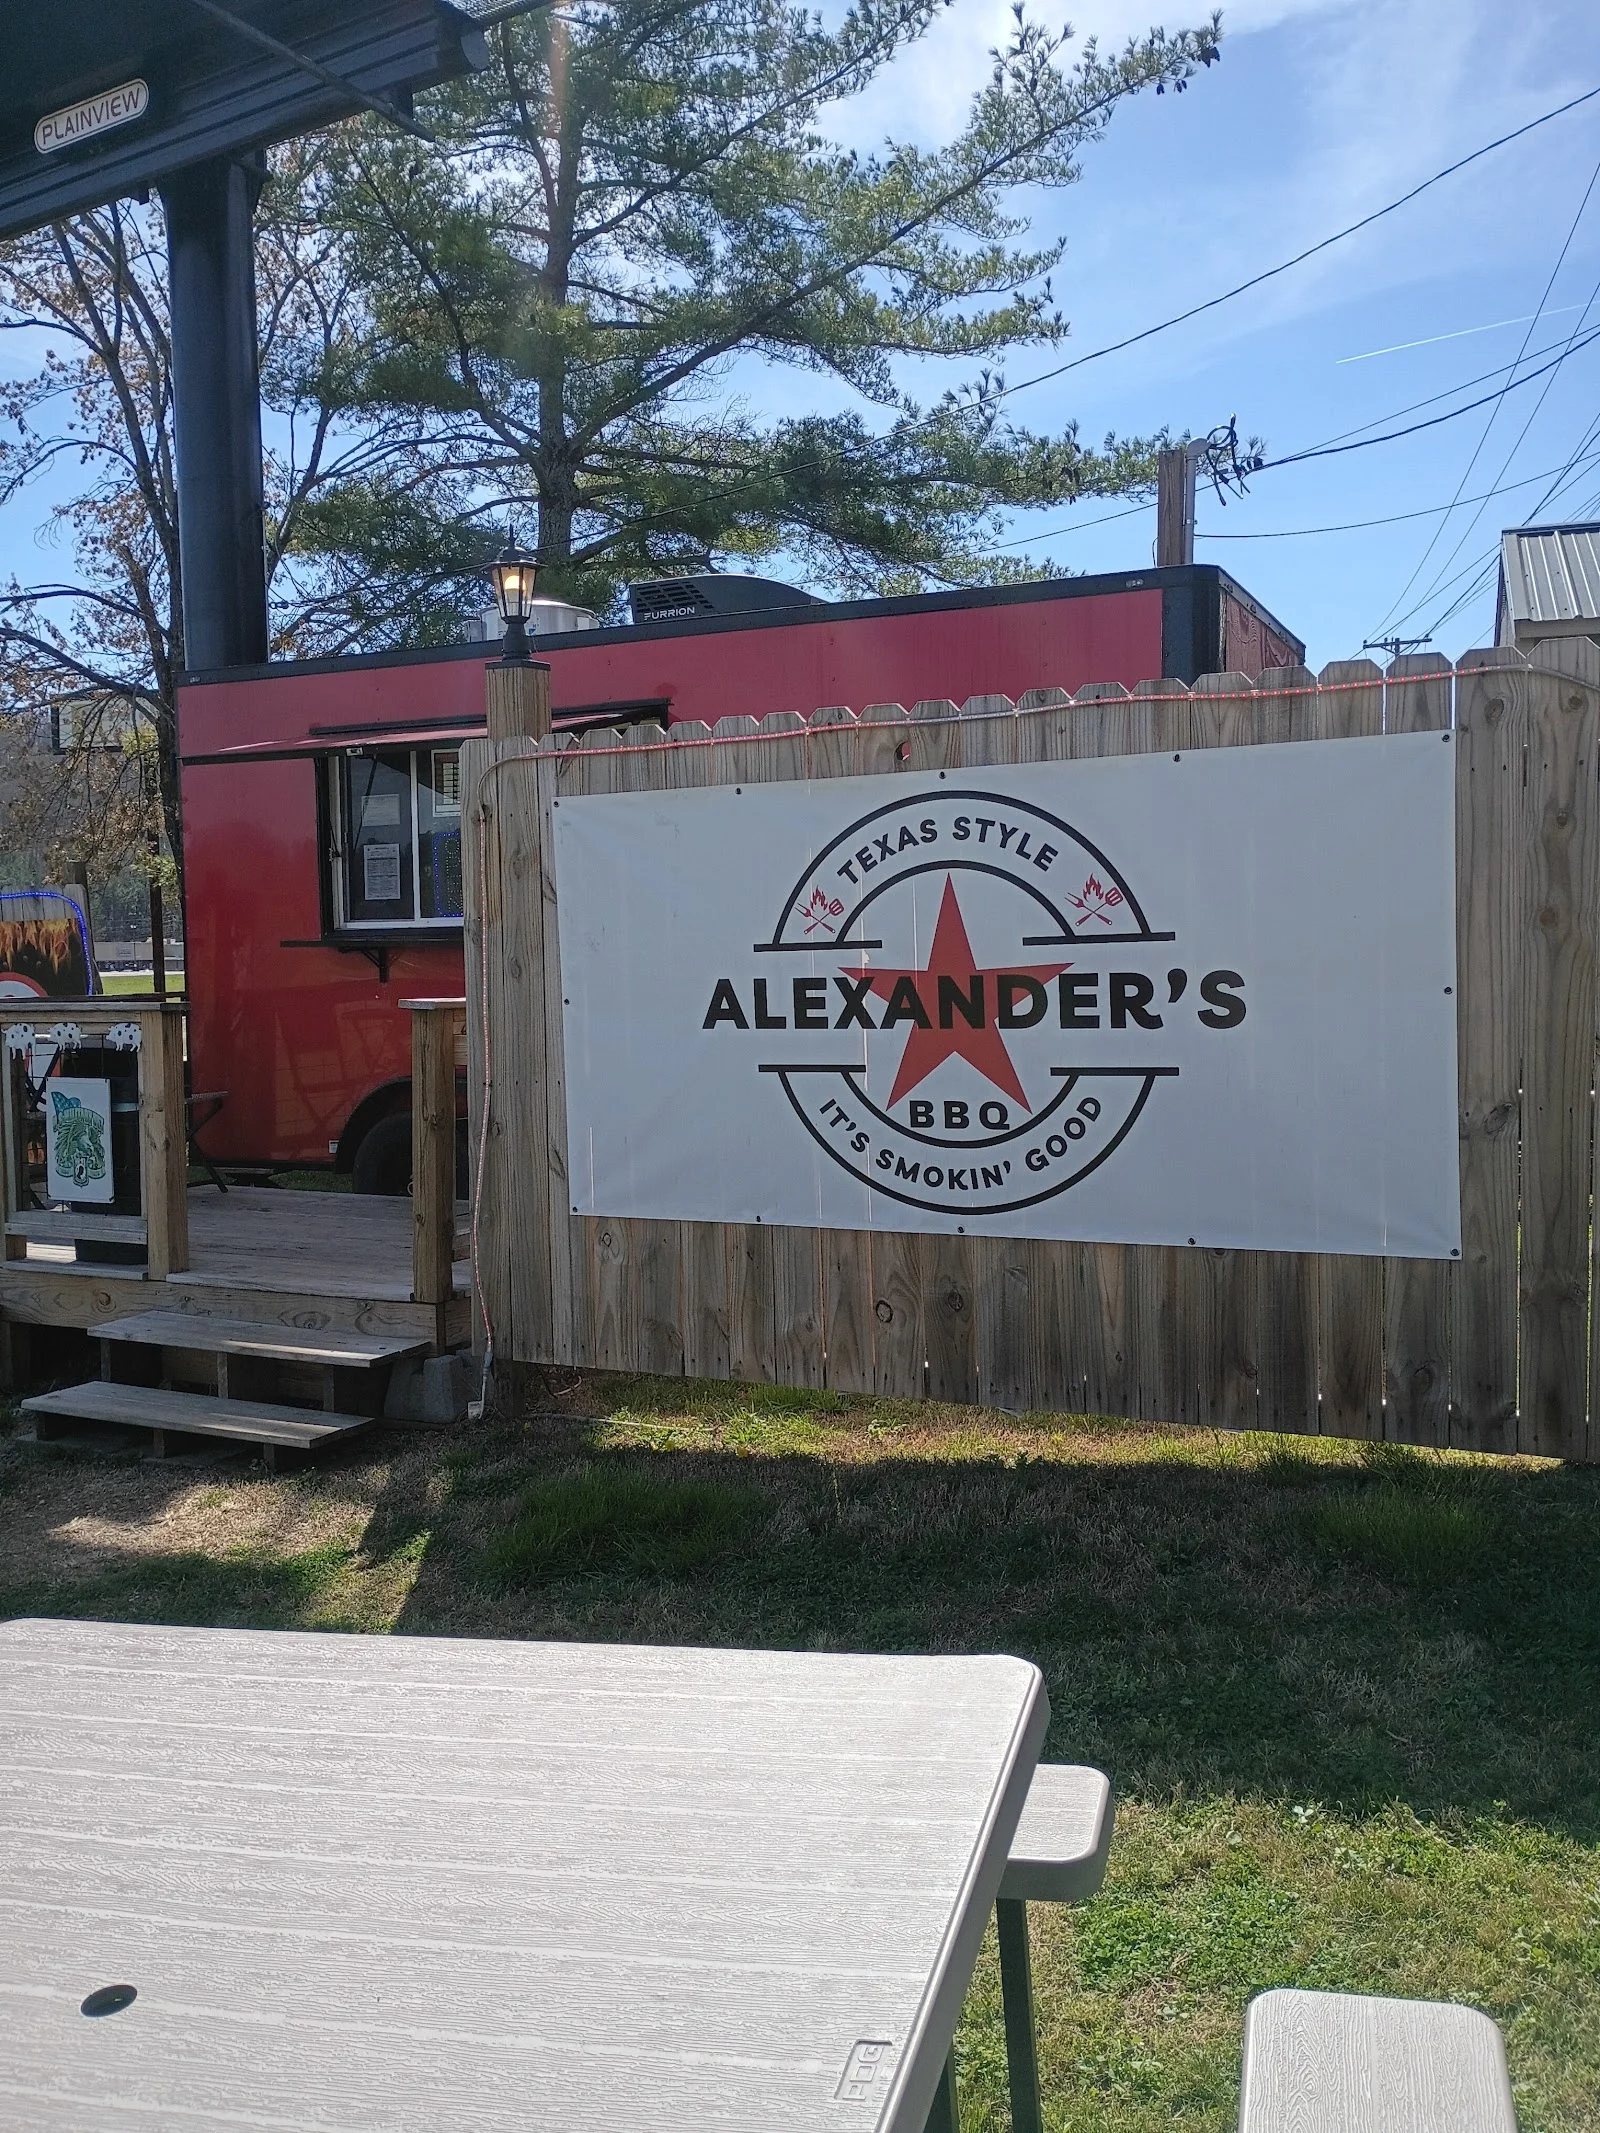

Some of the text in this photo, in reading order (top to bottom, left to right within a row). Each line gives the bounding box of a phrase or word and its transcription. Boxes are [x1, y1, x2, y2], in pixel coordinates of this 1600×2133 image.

[42, 87, 140, 145] PLAINVIEW
[644, 606, 696, 621] FURRION
[836, 816, 1059, 885] TEXAS STYLE
[702, 968, 1247, 1030] ALEXANDER'S
[819, 1096, 1102, 1190] IT'S SMOKIN' GOOD
[909, 1100, 1010, 1131] BBQ
